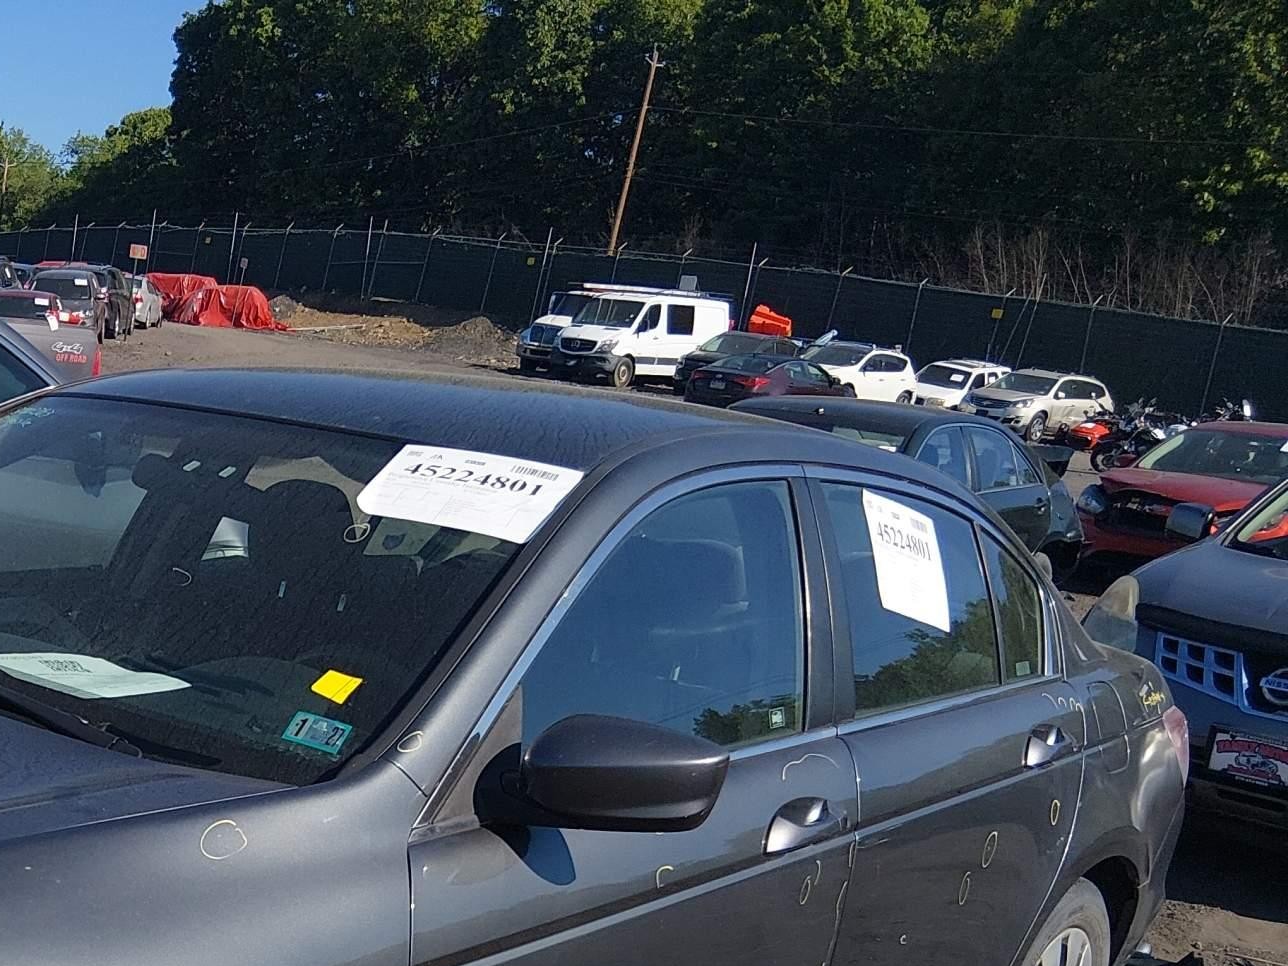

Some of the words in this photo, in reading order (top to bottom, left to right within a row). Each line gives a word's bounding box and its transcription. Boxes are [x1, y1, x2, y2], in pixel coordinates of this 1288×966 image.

[55, 353, 69, 363] OFF
[69, 353, 88, 364] ROAD
[404, 463, 544, 496] 45224801
[877, 521, 932, 561] 45224801
